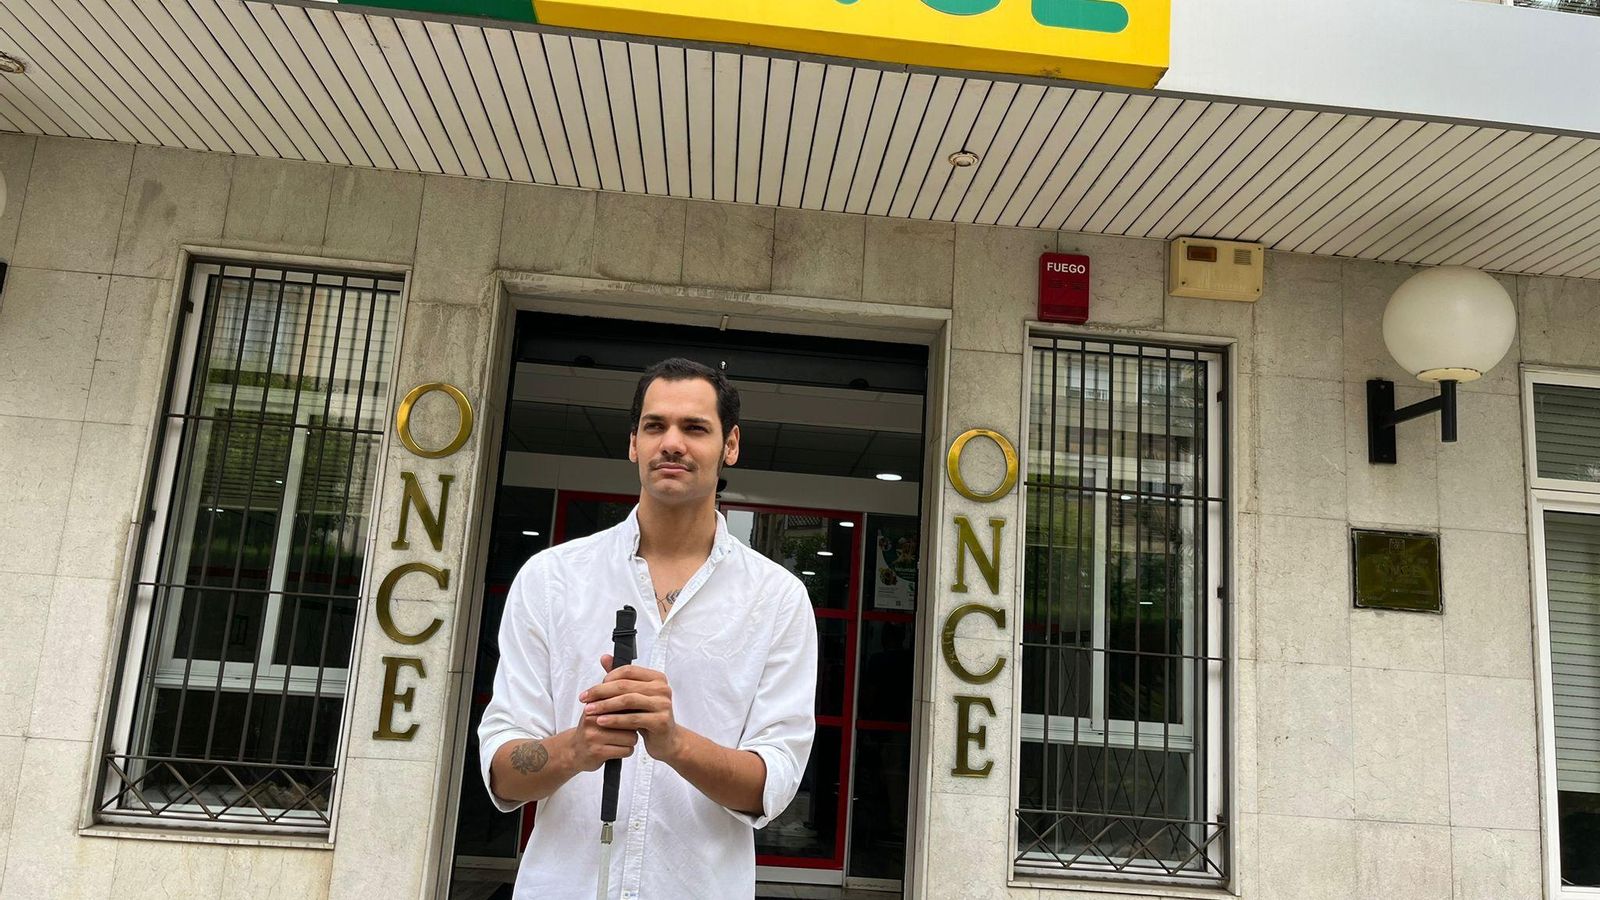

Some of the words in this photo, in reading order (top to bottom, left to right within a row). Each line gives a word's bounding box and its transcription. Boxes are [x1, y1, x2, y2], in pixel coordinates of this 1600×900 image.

[1047, 262, 1086, 274] FUEGO
[372, 382, 474, 742] ONCE
[941, 428, 1019, 778] ONCE
